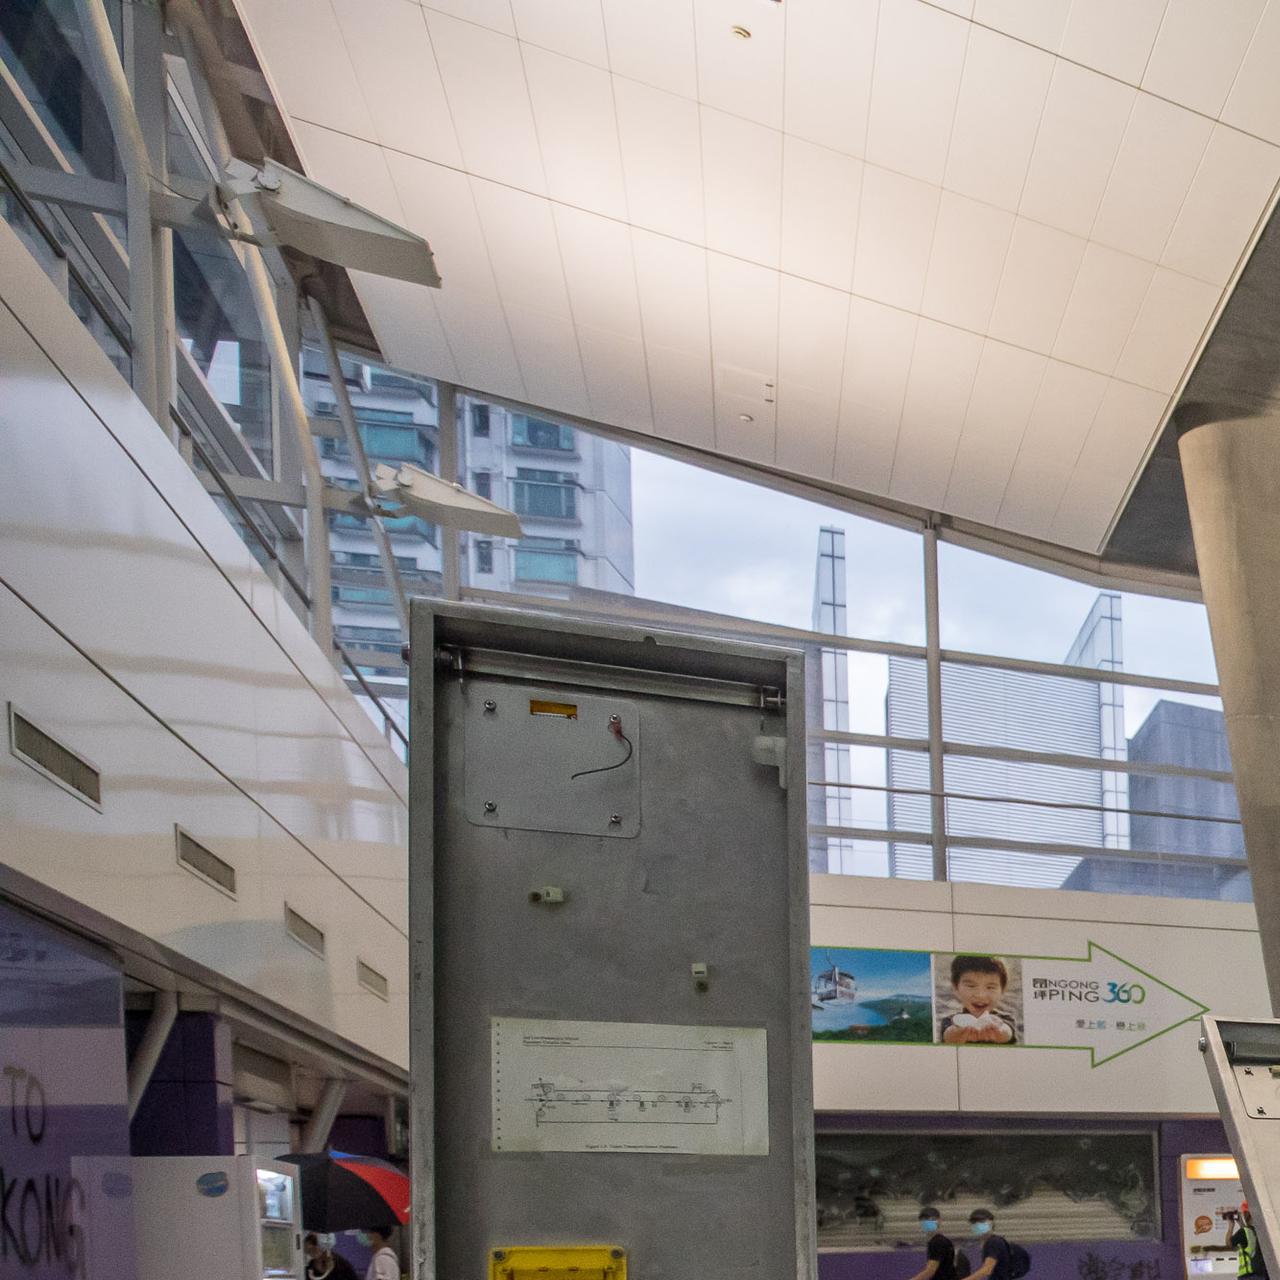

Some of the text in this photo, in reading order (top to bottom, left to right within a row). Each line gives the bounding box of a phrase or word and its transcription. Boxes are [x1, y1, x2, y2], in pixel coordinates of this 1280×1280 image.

[1048, 980, 1099, 990] NGONG
[1048, 989, 1100, 1002] PING
[1103, 982, 1145, 1004] 360
